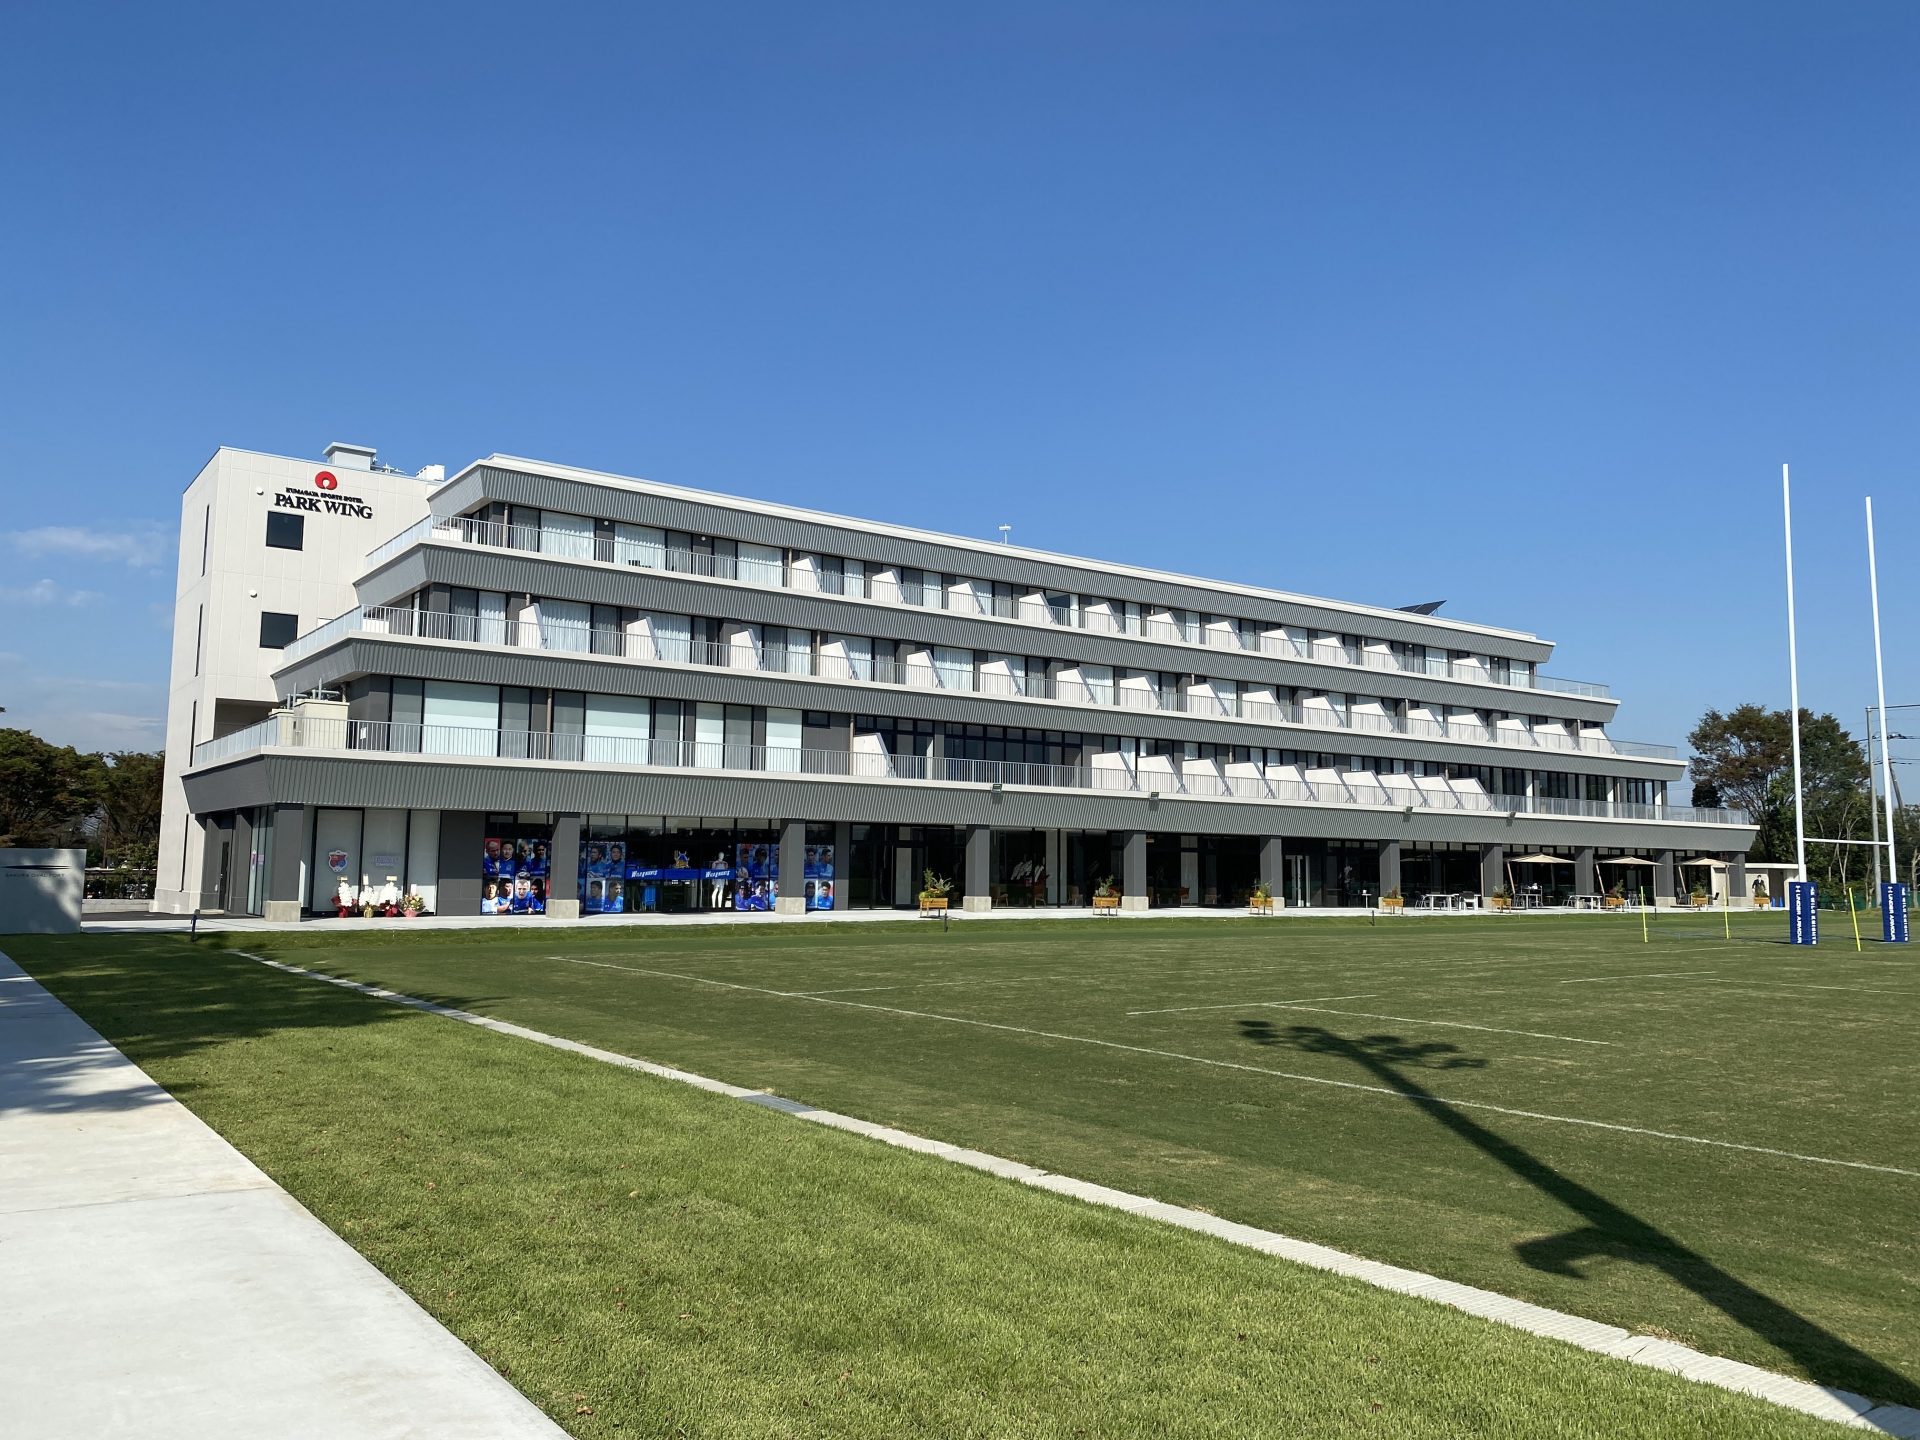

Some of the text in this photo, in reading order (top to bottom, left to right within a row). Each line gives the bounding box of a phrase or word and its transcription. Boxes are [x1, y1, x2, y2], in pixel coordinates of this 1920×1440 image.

[274, 493, 372, 519] PARK WING
[320, 492, 342, 500] SPORTS
[343, 495, 363, 504] HOTEL
